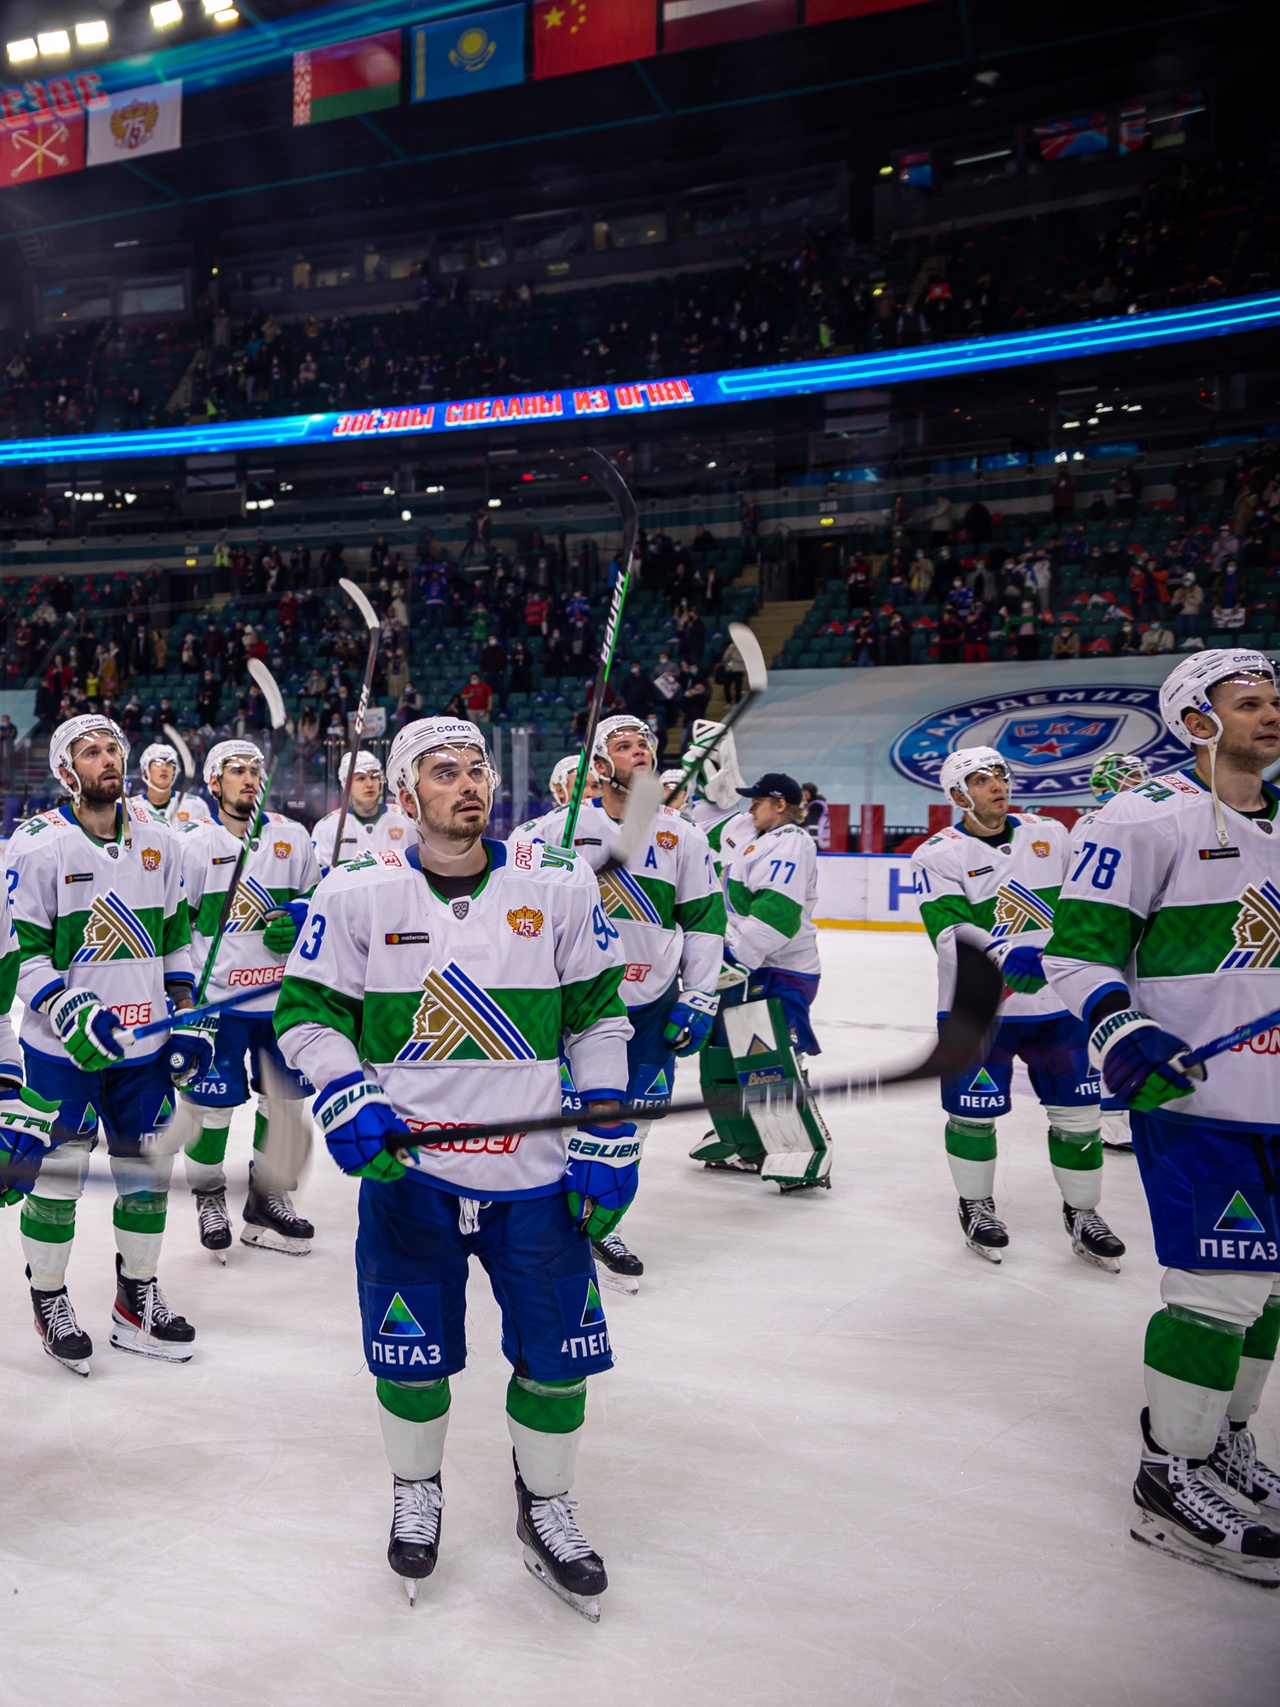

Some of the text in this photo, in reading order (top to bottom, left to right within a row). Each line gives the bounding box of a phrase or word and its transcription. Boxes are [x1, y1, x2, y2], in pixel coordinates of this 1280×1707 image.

[332, 378, 695, 437] ЗВЁЗДЫ СДЕЛАНЫ ИЗ ОГНЯ!
[926, 690, 1152, 738] АКАДЕМИЯ
[436, 723, 472, 734] согаз
[1014, 720, 1107, 738] СКА
[1136, 780, 1176, 804] FA
[1160, 776, 1199, 796] BET
[644, 845, 658, 869] A
[1070, 841, 1122, 890] 78
[770, 859, 796, 885] 77
[515, 917, 534, 932] 75
[299, 913, 326, 961] 3
[400, 934, 430, 942] mastercard
[192, 1082, 228, 1095] ЕГАЗ
[959, 1093, 1006, 1109] ПЕГАЗ
[567, 1138, 641, 1159] BAUER
[1200, 1238, 1279, 1261] ПЕГАЗ
[372, 1340, 442, 1366] ПЕГАЗ
[1172, 1501, 1210, 1530] CCM
